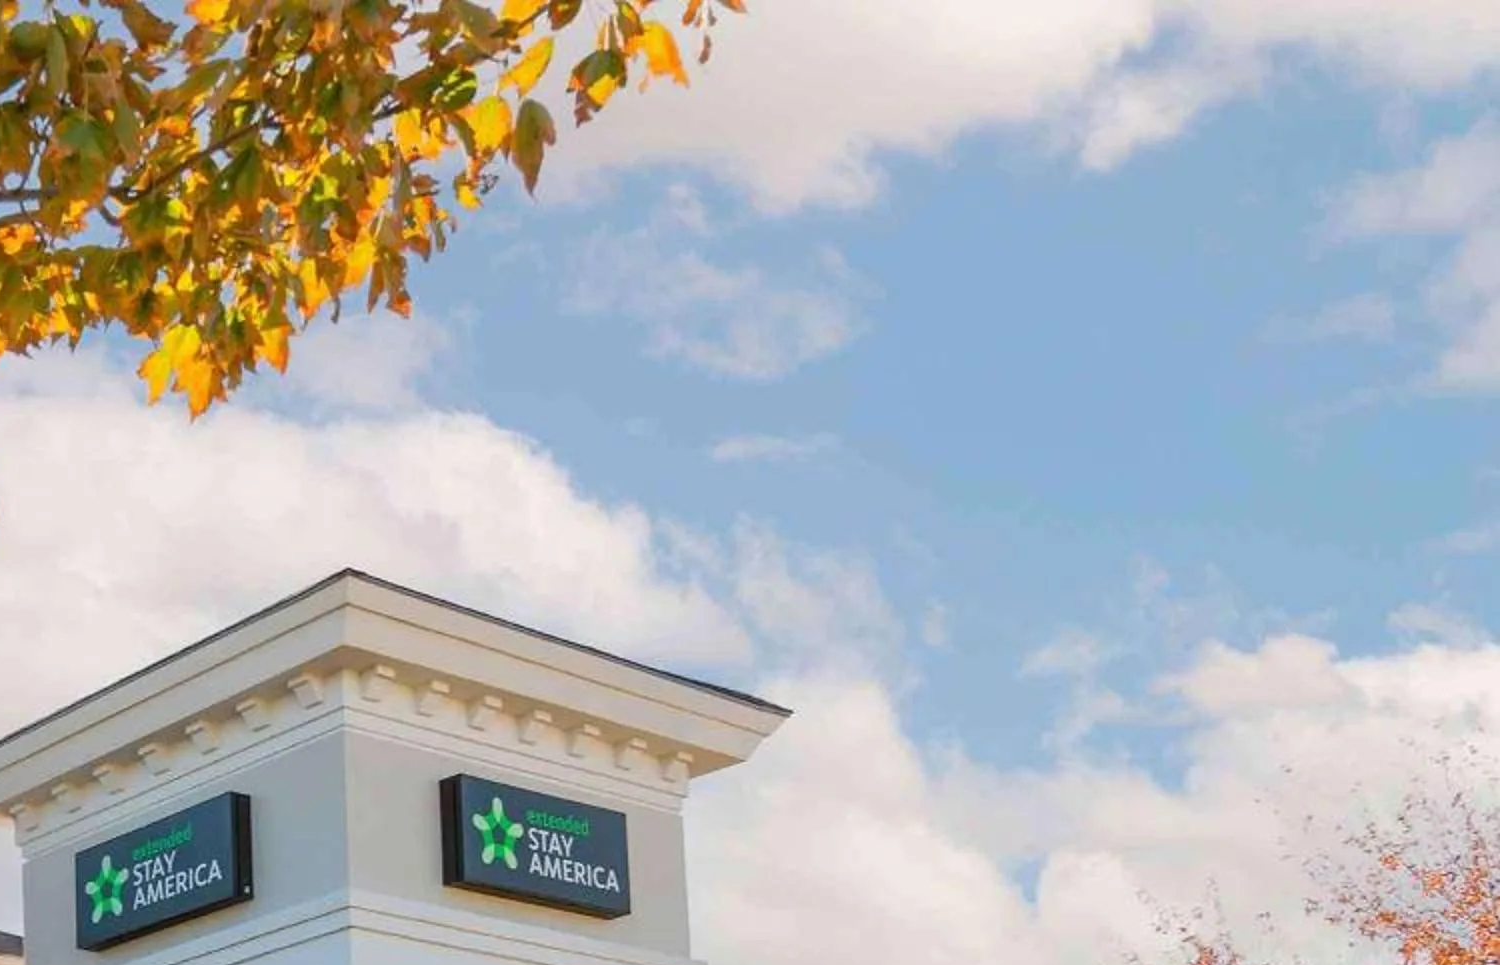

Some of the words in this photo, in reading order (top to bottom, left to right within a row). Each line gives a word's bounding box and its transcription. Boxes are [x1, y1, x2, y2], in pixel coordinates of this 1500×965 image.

[526, 809, 590, 835] extended
[133, 822, 192, 859] extended
[528, 827, 574, 857] STAY
[133, 850, 177, 886] STAY
[133, 859, 223, 911] AMERICA
[529, 853, 619, 892] AMERICA
